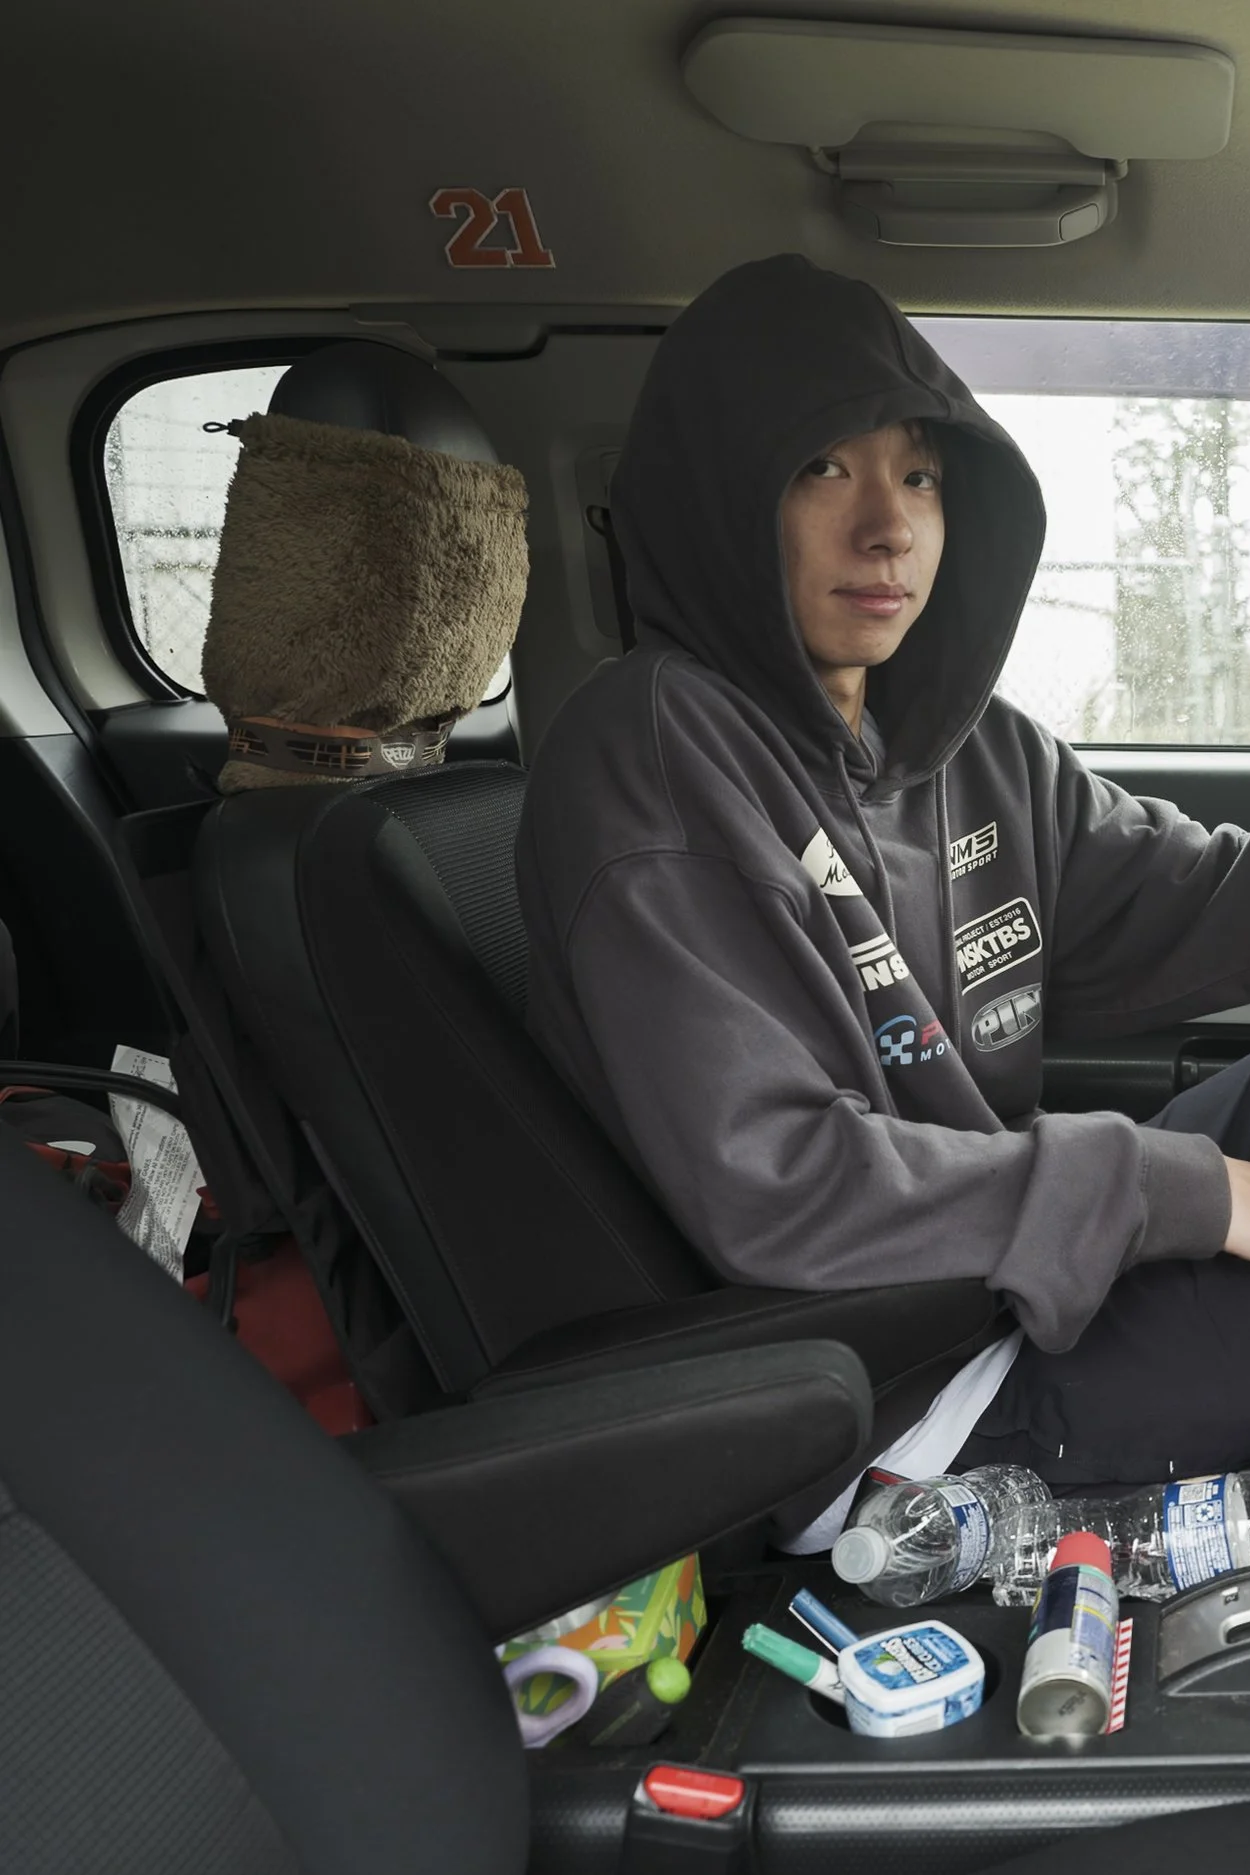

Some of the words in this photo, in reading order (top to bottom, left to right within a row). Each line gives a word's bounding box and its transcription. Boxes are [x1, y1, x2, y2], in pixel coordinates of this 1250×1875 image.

[428, 187, 556, 269] 21
[383, 746, 414, 763] PETZL
[967, 849, 998, 872] SPORT
[988, 951, 1013, 969] SPORT
